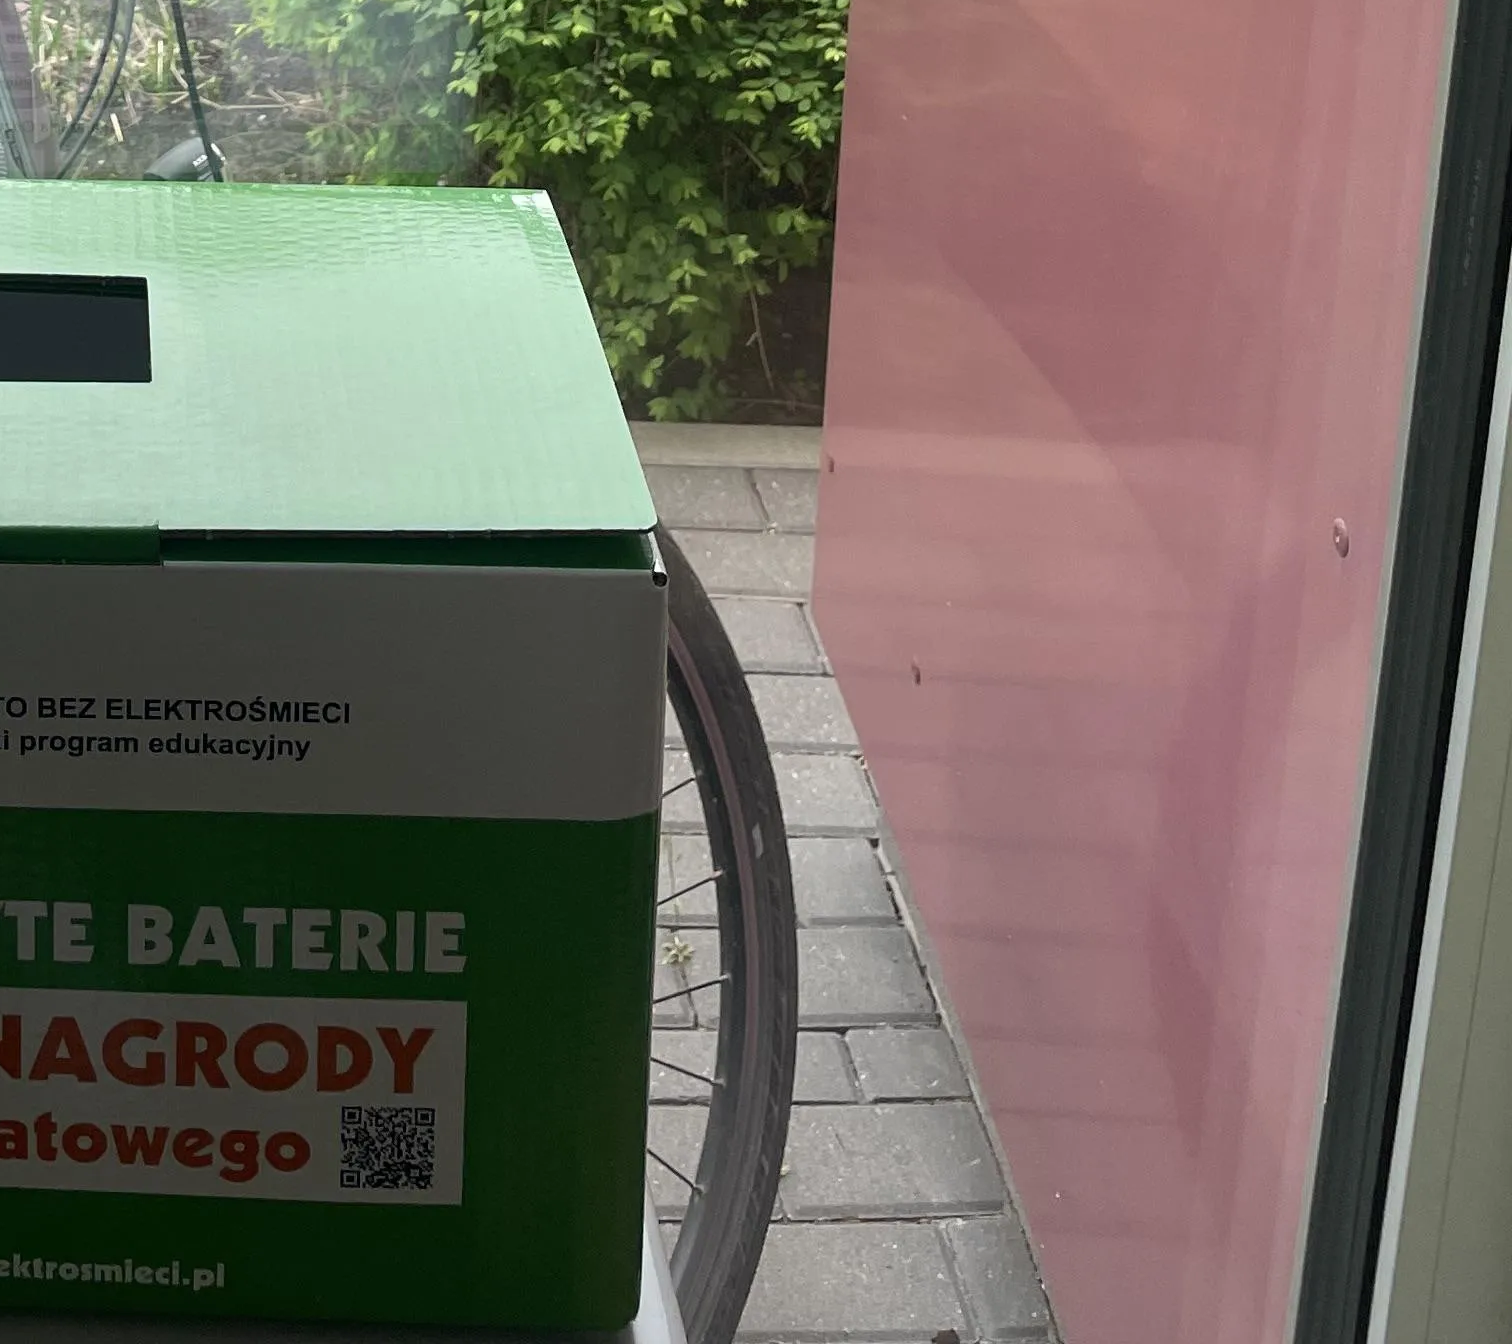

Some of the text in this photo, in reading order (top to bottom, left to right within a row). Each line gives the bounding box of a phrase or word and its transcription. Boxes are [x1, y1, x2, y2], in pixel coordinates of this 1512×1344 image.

[37, 695, 97, 720] BEZ
[105, 694, 350, 725] ELEKTROŚMIECI
[19, 734, 139, 758] program
[148, 731, 311, 763] edukacyjny
[127, 902, 469, 975] BATERIE
